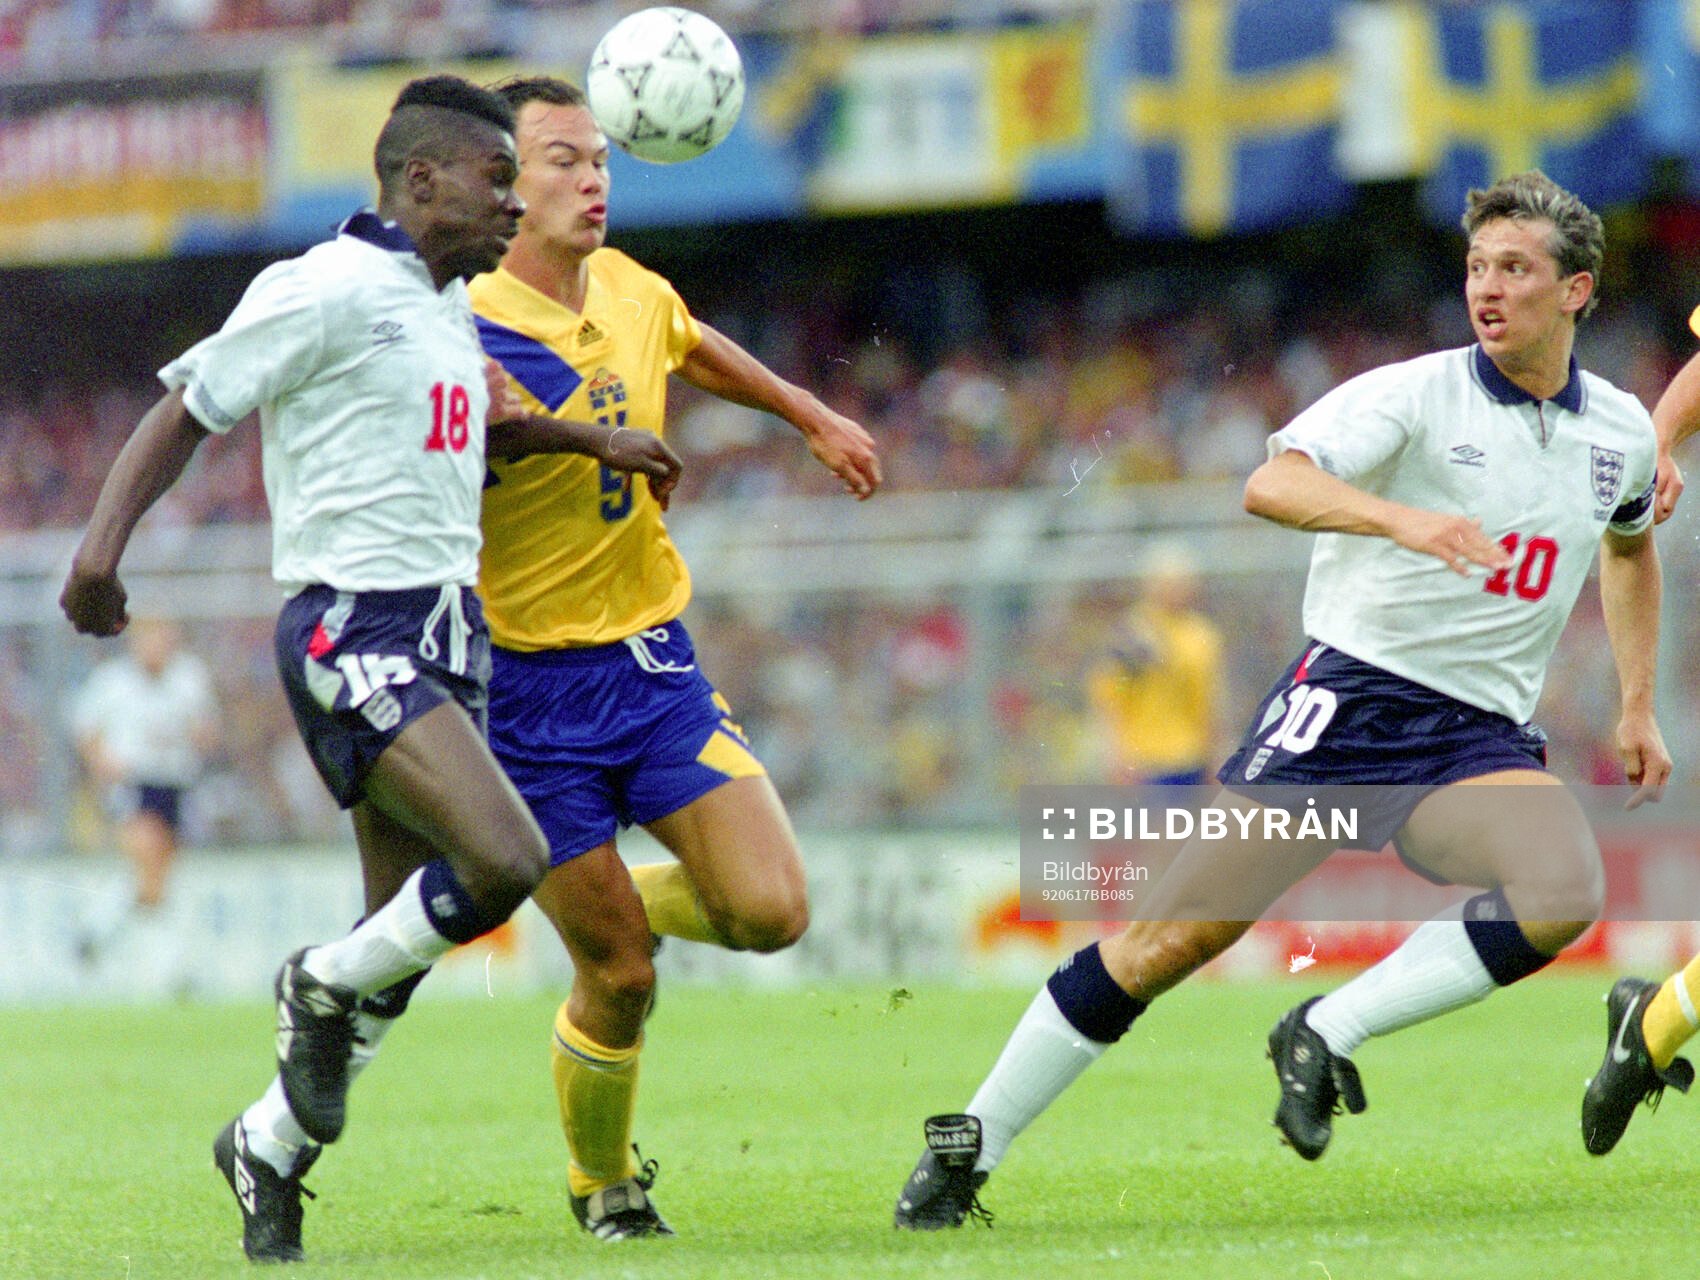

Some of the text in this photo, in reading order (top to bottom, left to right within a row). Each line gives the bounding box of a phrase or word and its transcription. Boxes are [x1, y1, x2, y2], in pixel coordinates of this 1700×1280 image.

[423, 381, 470, 454] 18
[1483, 531, 1560, 602] 10
[1264, 683, 1337, 754] 10
